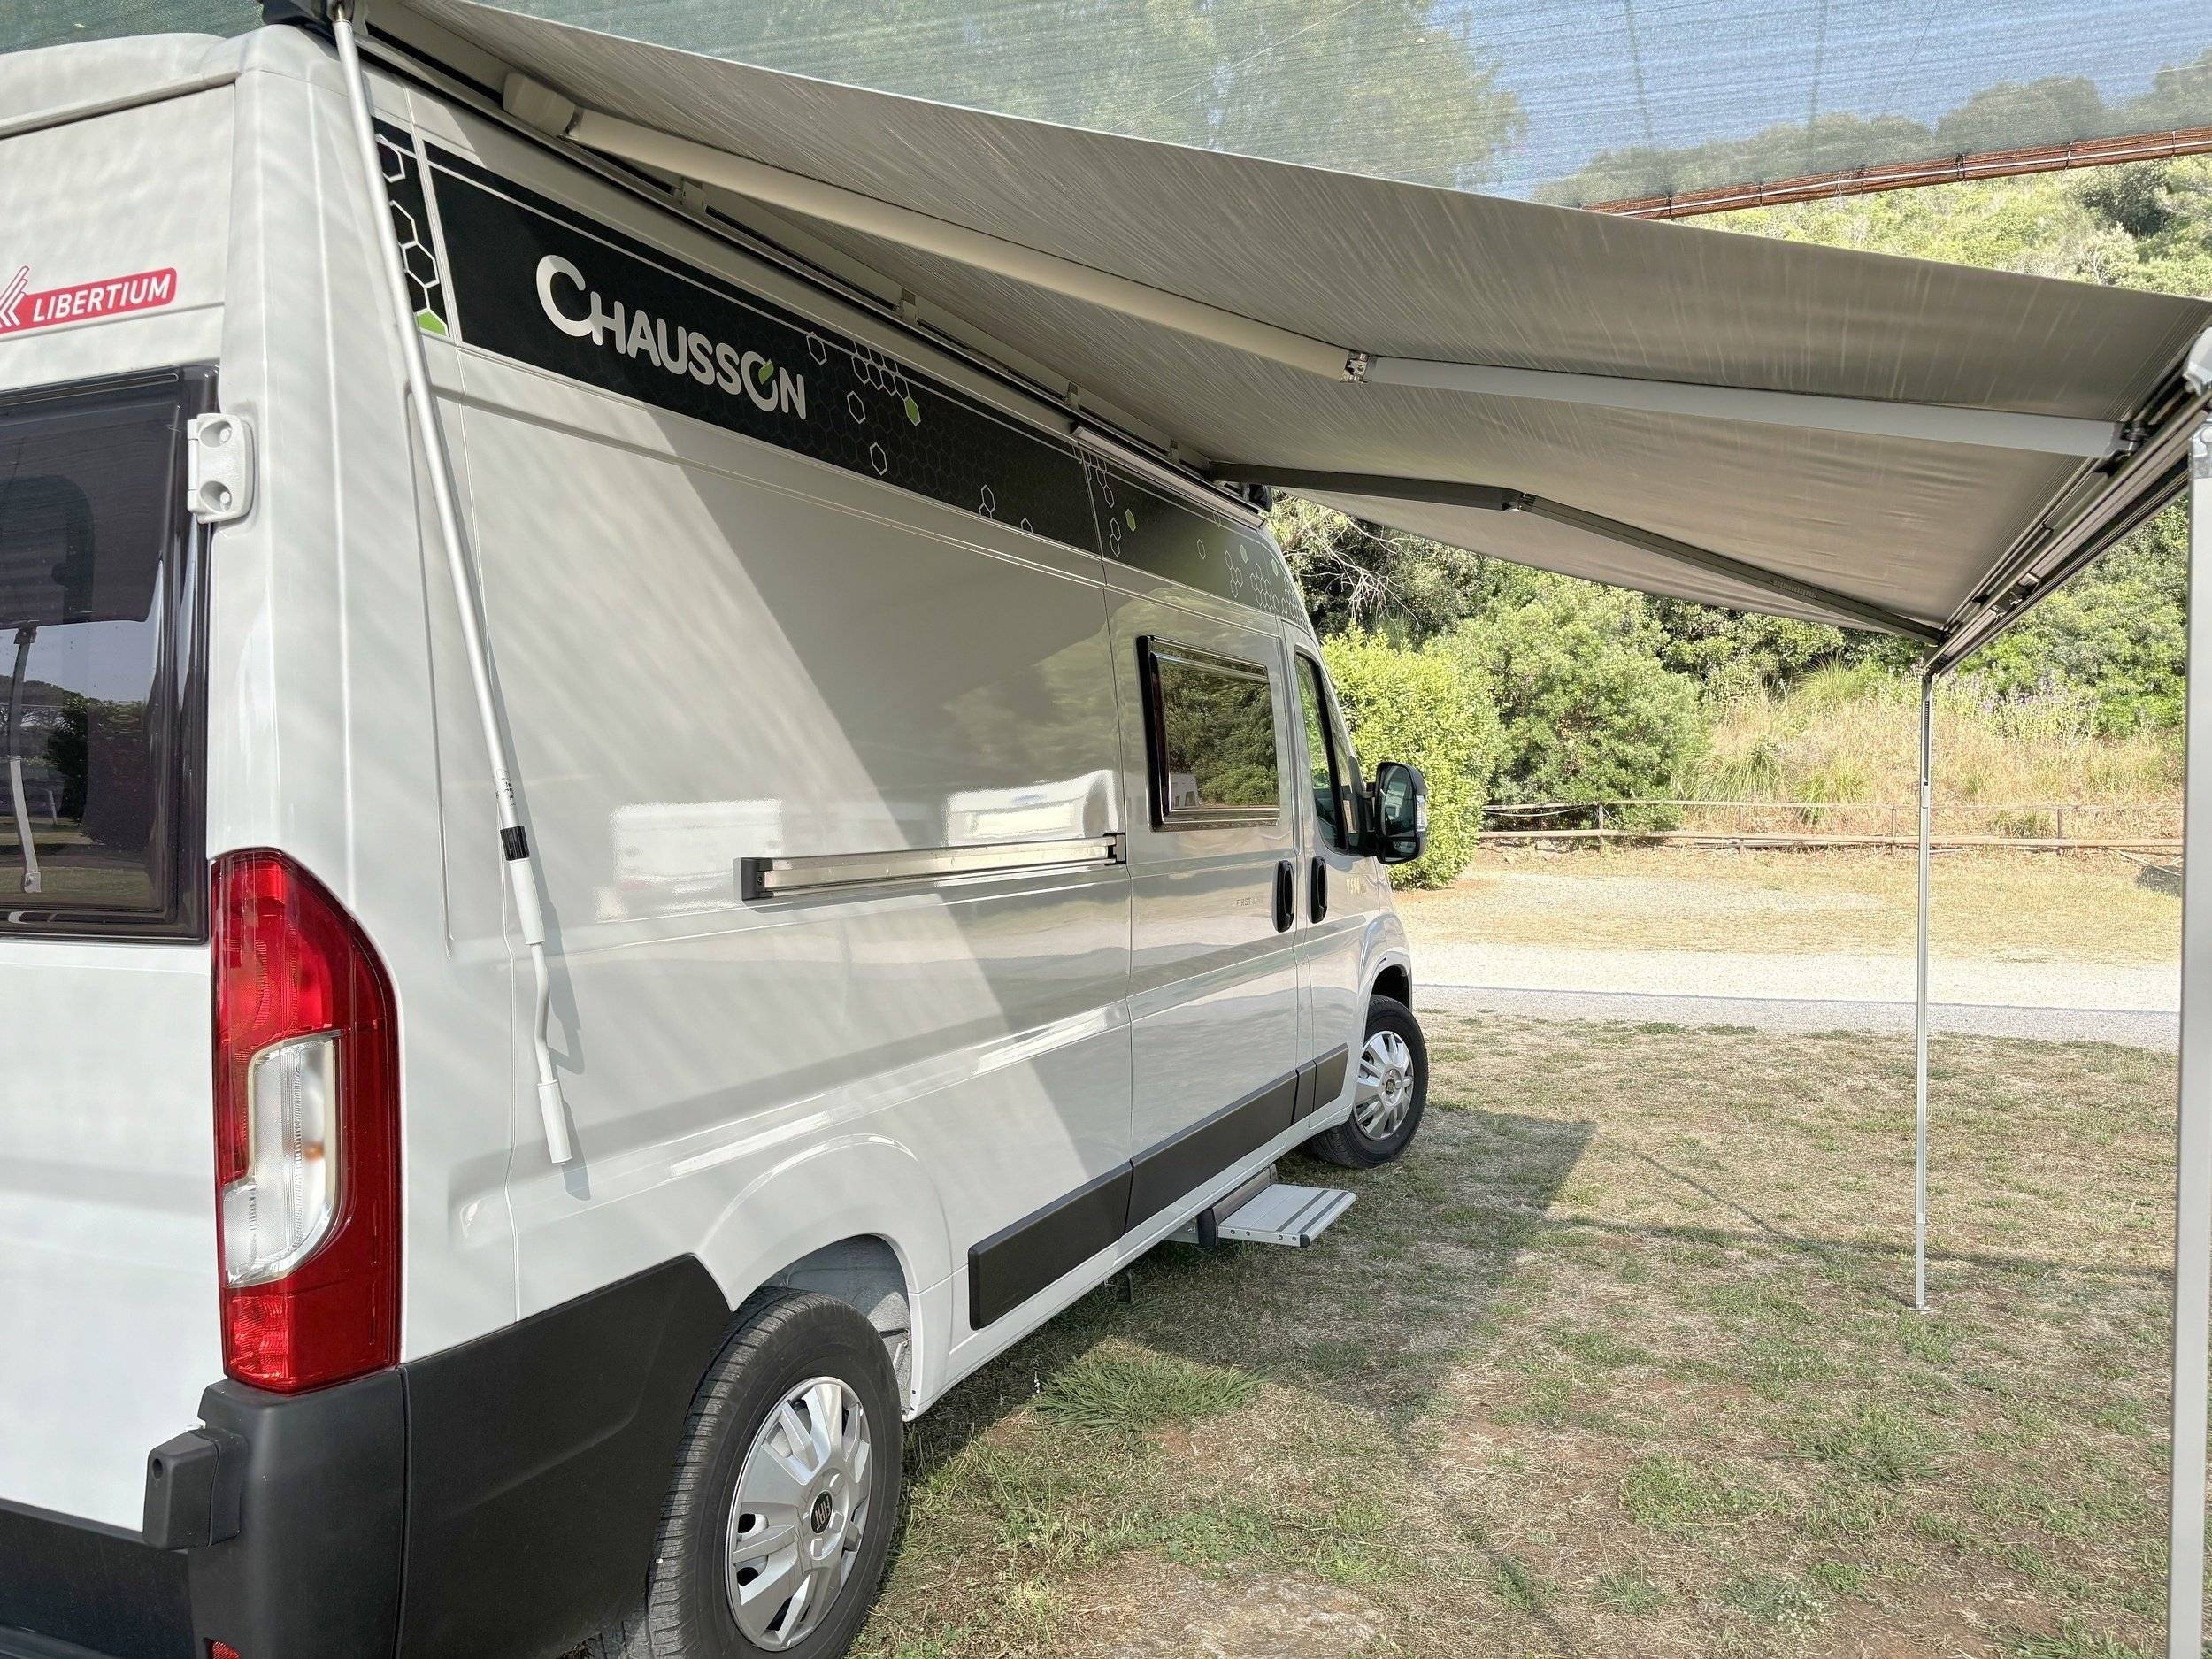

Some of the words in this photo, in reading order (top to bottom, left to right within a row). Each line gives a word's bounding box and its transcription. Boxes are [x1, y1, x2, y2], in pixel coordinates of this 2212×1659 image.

[33, 273, 172, 322] LIBERTIUM
[536, 254, 807, 420] CHAUSSON
[814, 1495, 832, 1531] FIAT
